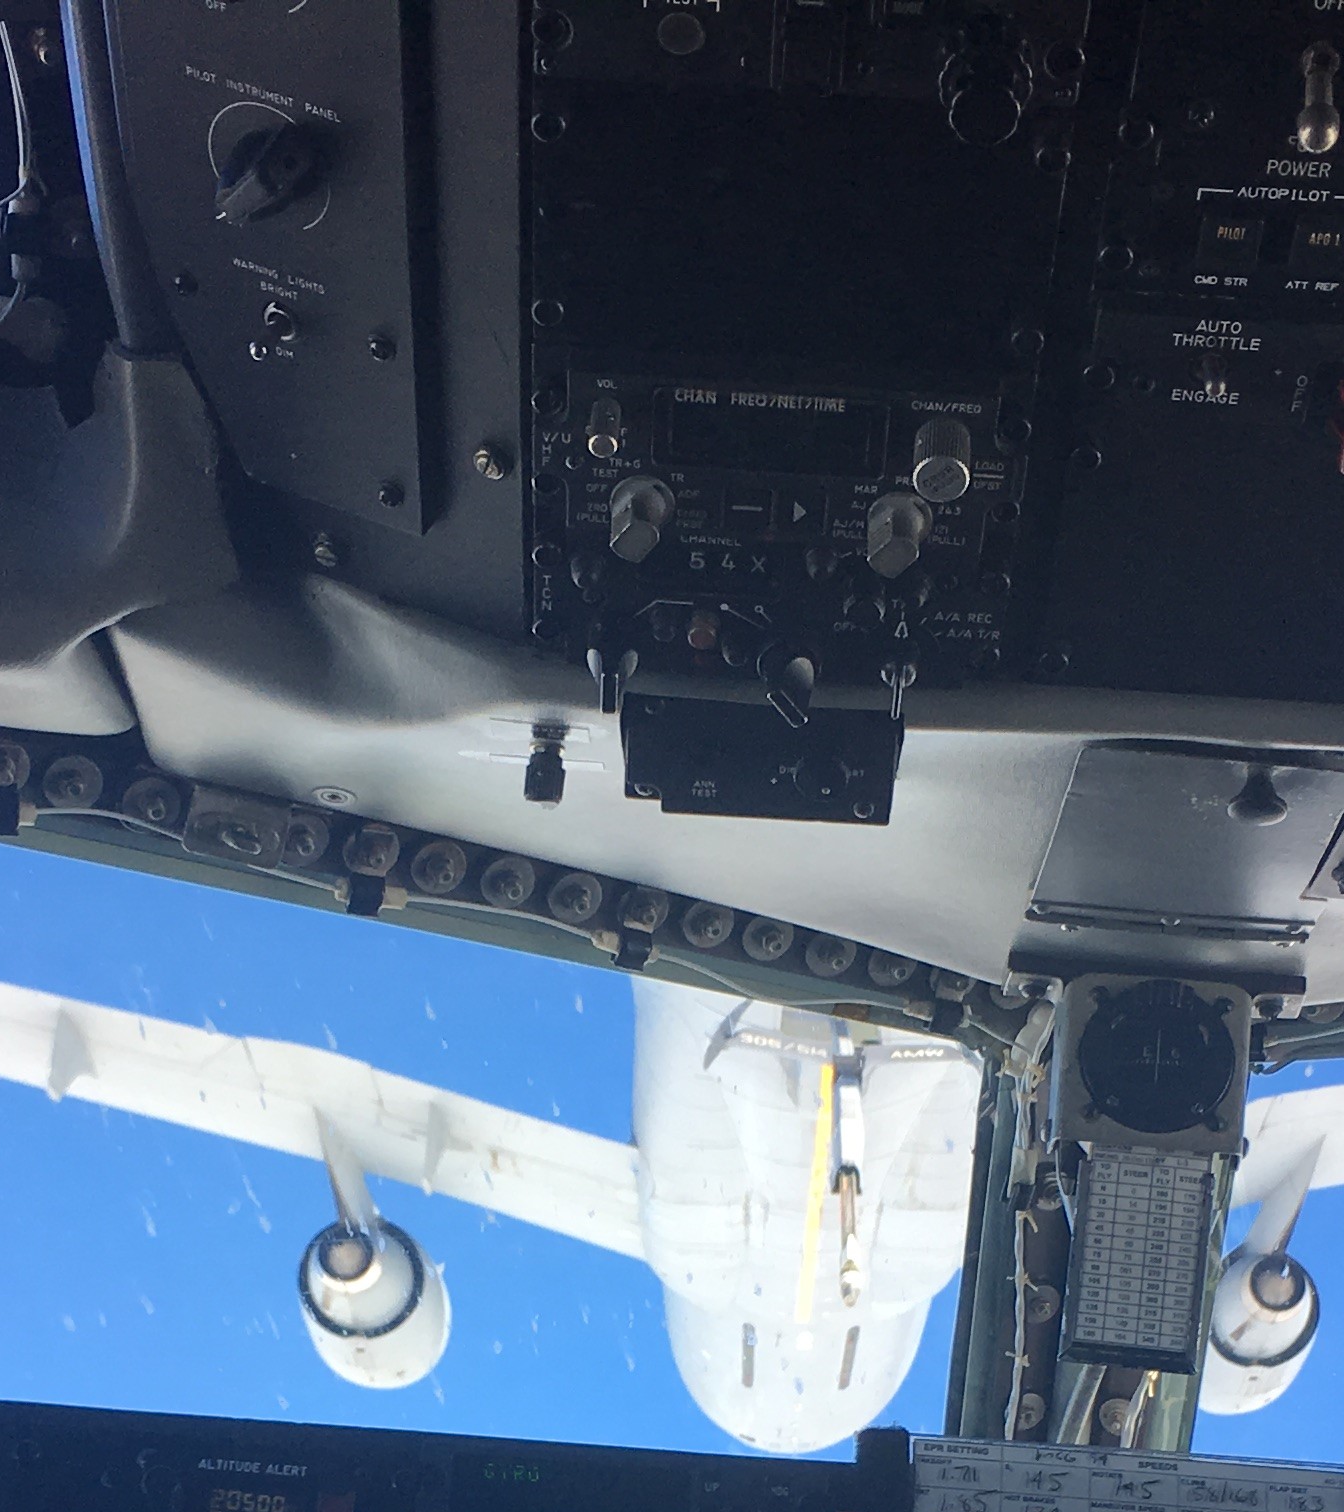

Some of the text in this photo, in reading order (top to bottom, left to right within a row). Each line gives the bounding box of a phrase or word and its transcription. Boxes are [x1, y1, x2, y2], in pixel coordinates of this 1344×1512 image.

[185, 66, 341, 124] PILOT INSTRUMENT PANEL
[1266, 159, 1332, 178] POWER
[1237, 187, 1331, 202] AUTOPILOT
[1218, 226, 1246, 241] PILOT
[232, 258, 325, 295] WARNING LIGHTS
[1224, 276, 1248, 287] STR
[259, 281, 299, 301] BRIGHT
[1285, 280, 1339, 292] ATT REF
[1196, 320, 1242, 335] AUTO
[1172, 333, 1262, 351] THROTTLE
[275, 346, 294, 359] DIM
[597, 379, 617, 390] VOL
[674, 388, 716, 405] CHAN
[1171, 389, 1240, 406] ENGAGE
[911, 399, 982, 416] CHAN/FREQ
[592, 468, 619, 478] TEST
[671, 473, 684, 482] TR
[680, 535, 741, 547] CHANNEL
[689, 551, 766, 574] 5 4 X
[934, 612, 992, 624] A/A REC
[946, 629, 1000, 641] A/A T/R
[891, 1048, 945, 1060] AMW
[198, 1459, 308, 1477] ALTITUDE ALERT
[1138, 1462, 1178, 1471] SPEEDS
